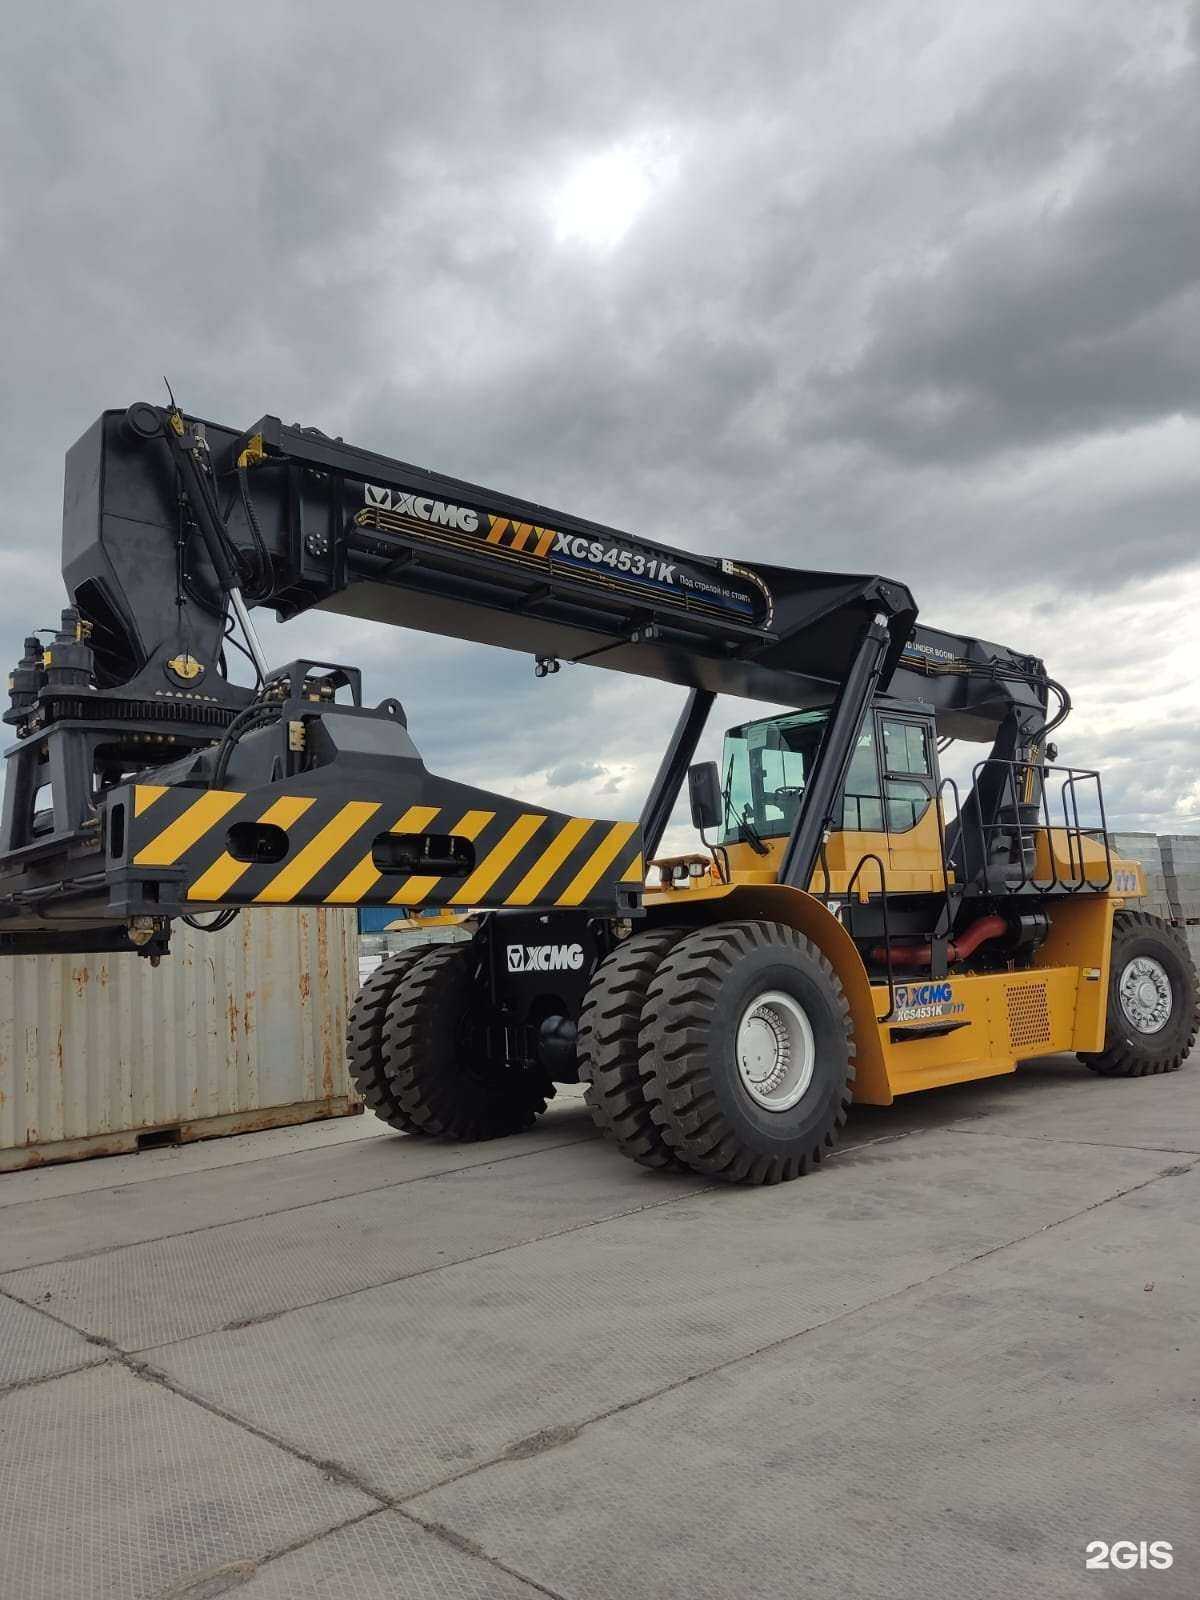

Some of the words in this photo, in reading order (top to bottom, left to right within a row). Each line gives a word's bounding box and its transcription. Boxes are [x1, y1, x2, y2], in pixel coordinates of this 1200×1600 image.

[391, 492, 479, 533] XCMG
[552, 532, 676, 584] XCS4531K
[680, 575, 693, 588] Под
[694, 581, 721, 595] стрелой
[913, 642, 934, 655] UNDER
[525, 943, 584, 971] XCMG
[911, 982, 952, 1006] XCMG
[897, 1004, 943, 1021] XCS4531K
